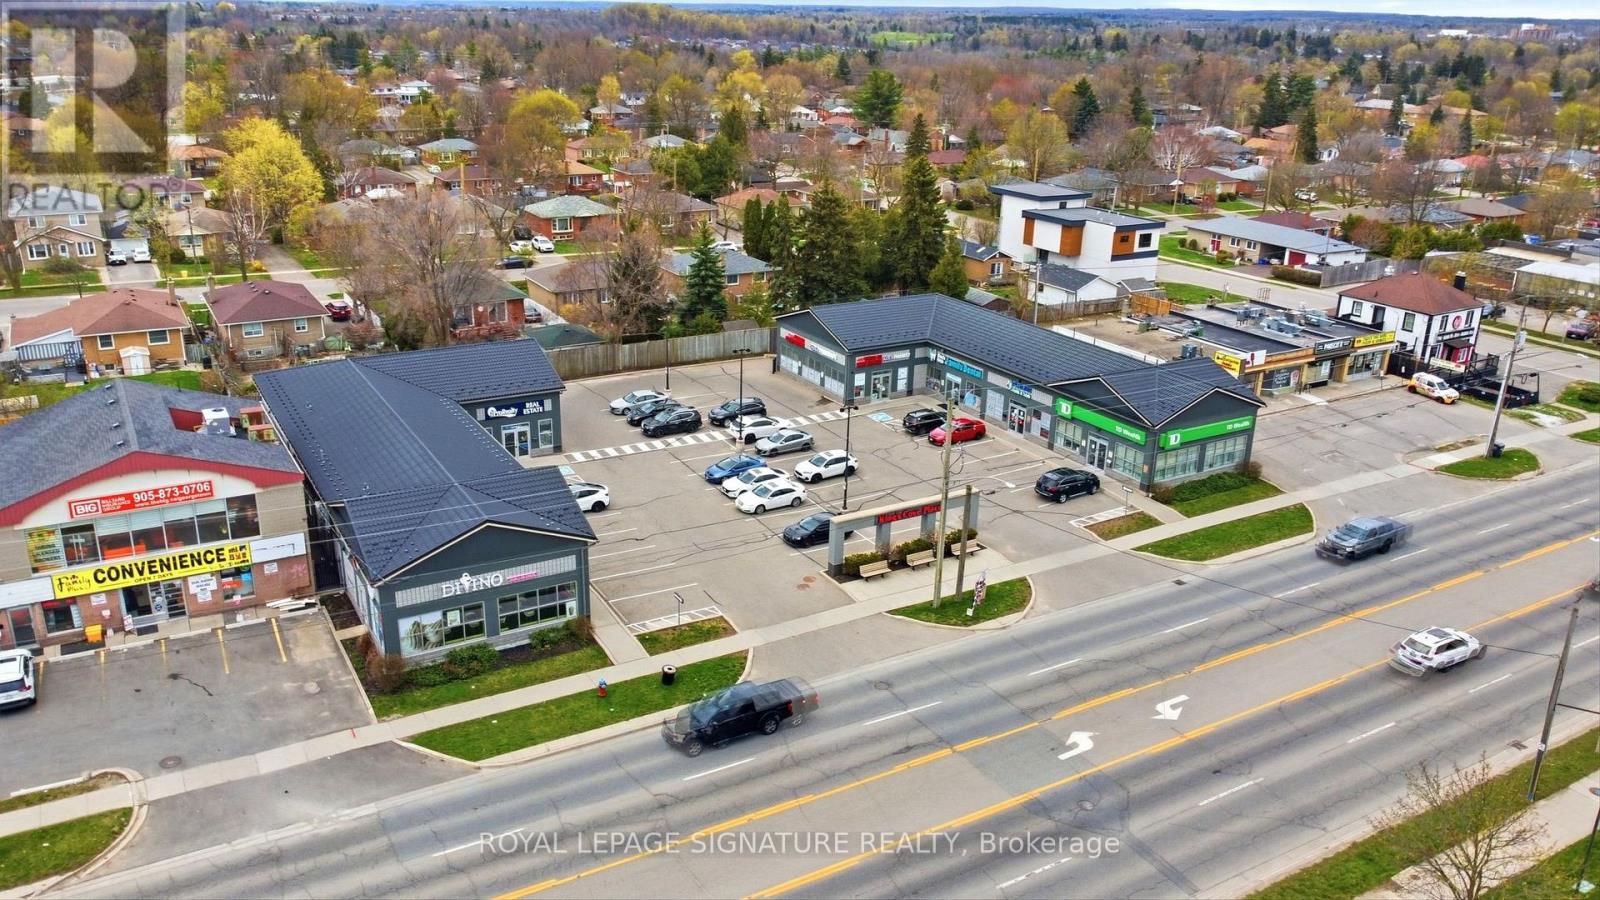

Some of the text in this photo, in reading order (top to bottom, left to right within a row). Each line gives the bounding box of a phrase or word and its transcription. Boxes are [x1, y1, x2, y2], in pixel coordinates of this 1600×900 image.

[523, 407, 543, 415] ESTATE
[1059, 402, 1071, 414] TD
[1168, 434, 1180, 445] TD
[133, 482, 210, 503] 905-873-0706
[76, 503, 97, 514] BIG
[93, 547, 227, 584] CONVENIENCE
